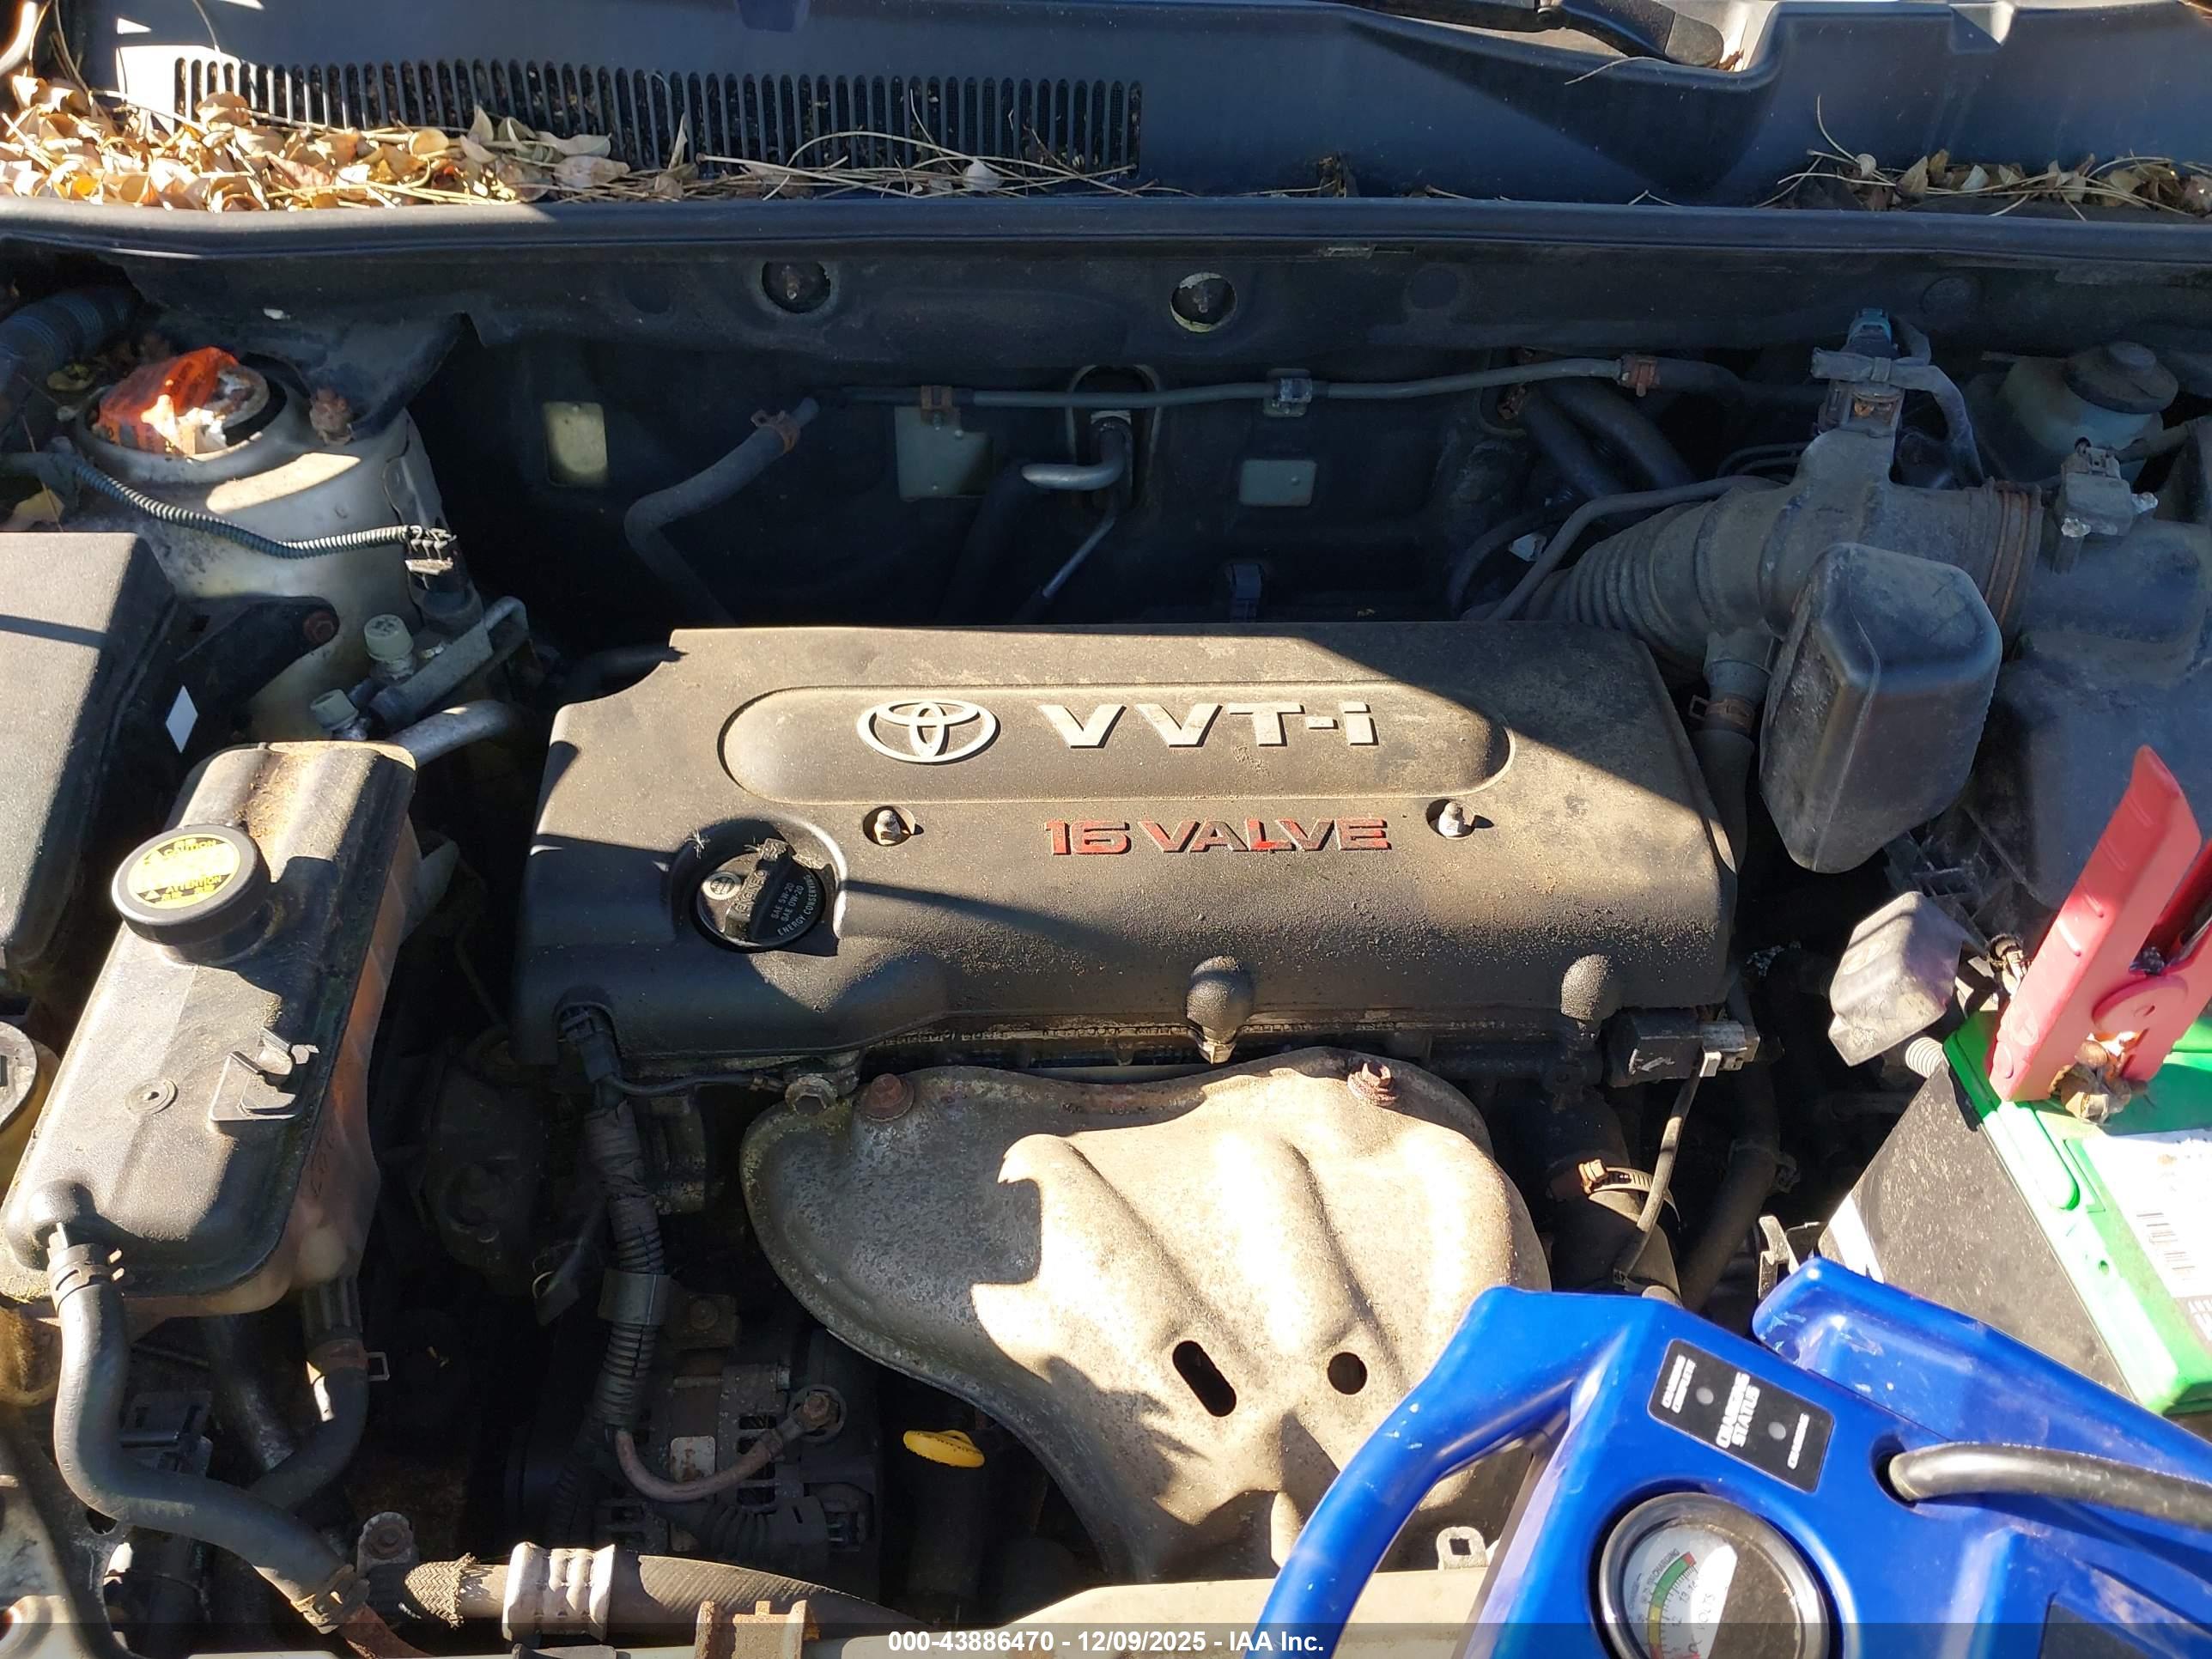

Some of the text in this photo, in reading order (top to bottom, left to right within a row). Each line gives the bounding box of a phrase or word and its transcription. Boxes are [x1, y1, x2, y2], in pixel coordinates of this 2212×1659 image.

[1037, 702, 1378, 748] VVT-i
[1045, 818, 1391, 855] 16 VALVE
[166, 875, 222, 894] ATTENTION
[770, 904, 783, 919] SAE
[776, 874, 817, 936] ENERGY CONSERVING
[781, 908, 792, 921] SAE
[1731, 1384, 1760, 1448] STATUS
